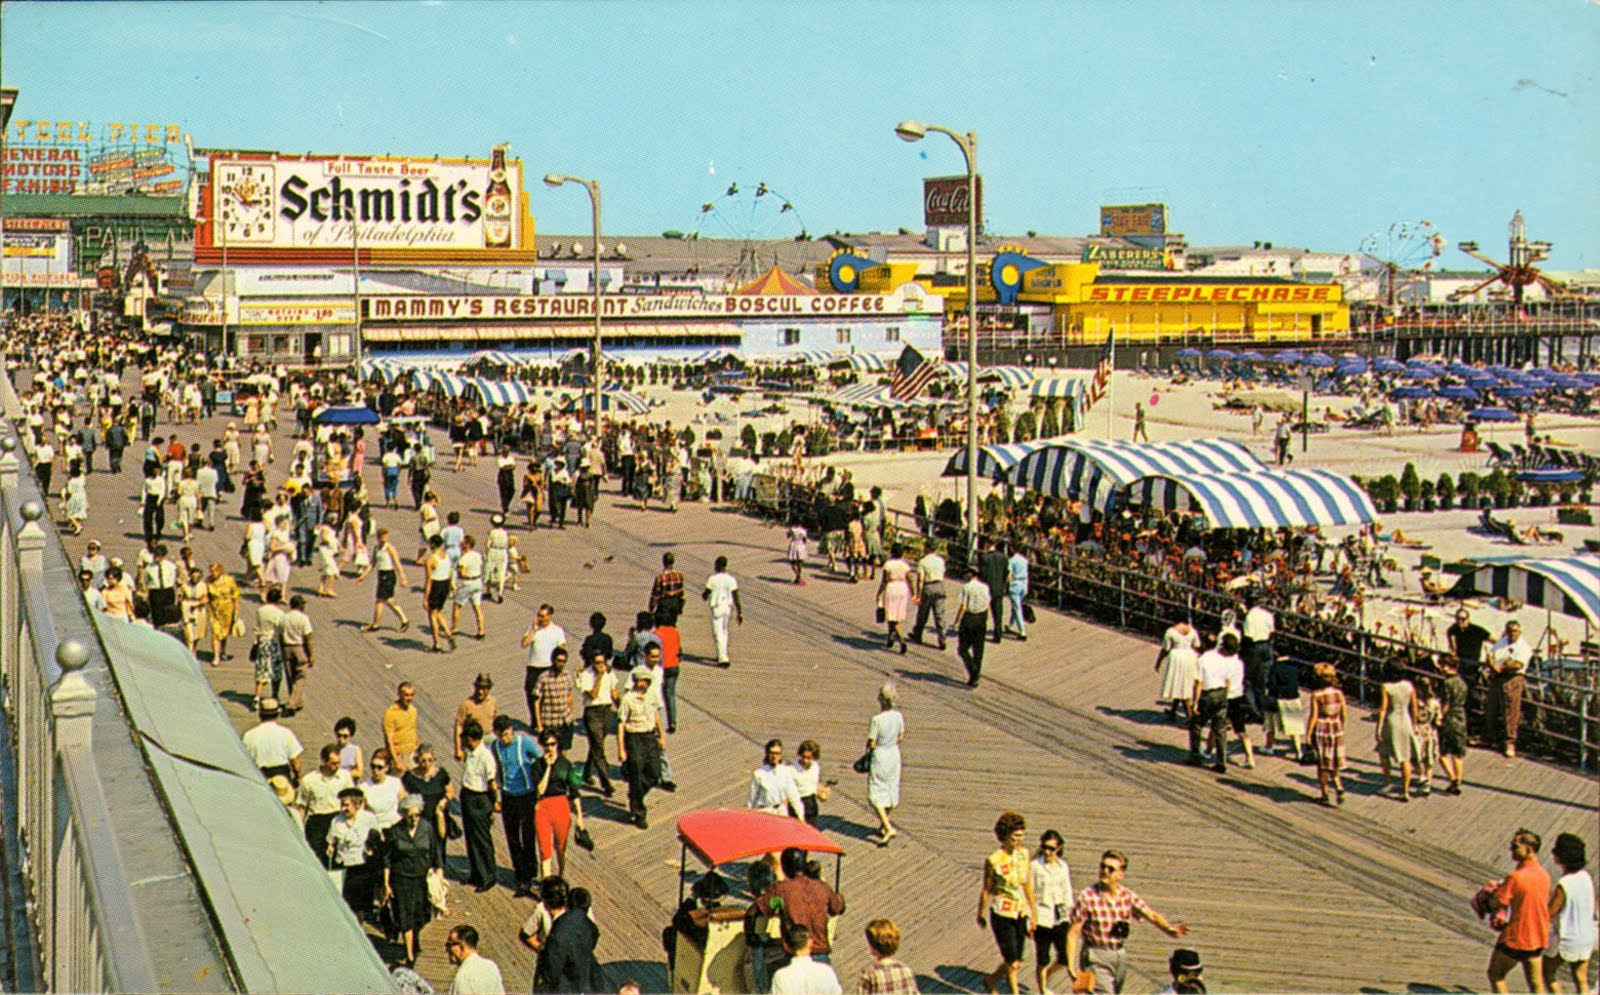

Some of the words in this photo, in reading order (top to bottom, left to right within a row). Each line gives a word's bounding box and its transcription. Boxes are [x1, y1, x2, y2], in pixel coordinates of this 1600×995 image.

[2, 120, 92, 141] TEEL
[109, 123, 181, 143] PIER
[2, 163, 81, 176] MOTORS
[328, 162, 351, 173] Full
[358, 163, 394, 174] Taste
[400, 164, 429, 175] Beer
[2, 178, 76, 193] EXHIBIT
[280, 174, 482, 223] Schmidt's
[303, 224, 324, 245] of
[326, 223, 454, 246] Philadelphia
[1090, 286, 1331, 301] STEEPLECHASE
[375, 299, 483, 316] MAMMY'S
[493, 299, 628, 315] RESTAURANT
[631, 295, 723, 314] Sandwiches
[725, 297, 802, 313] BOSCUL
[812, 296, 885, 312] COFFEE
